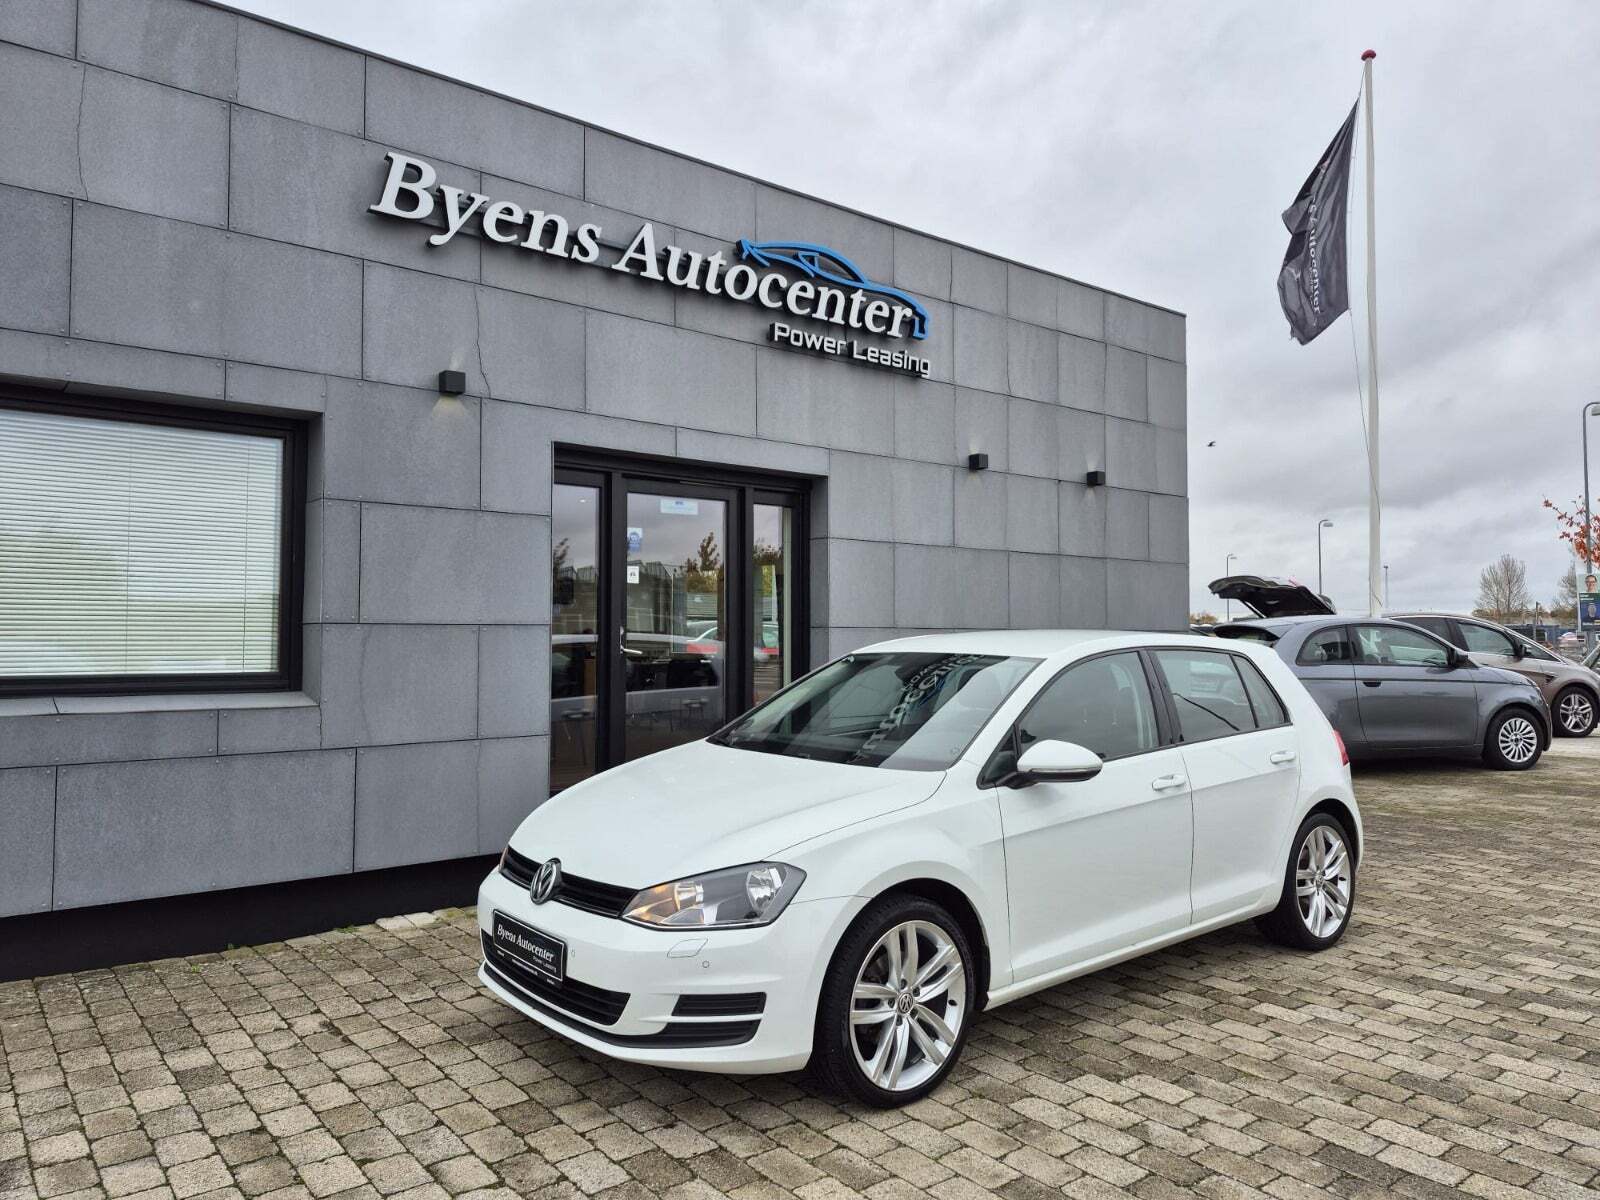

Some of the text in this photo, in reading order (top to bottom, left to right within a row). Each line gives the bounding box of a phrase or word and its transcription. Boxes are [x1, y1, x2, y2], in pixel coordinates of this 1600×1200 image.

[369, 151, 913, 338] Byens Autocenter
[774, 321, 931, 378] Power Leasing
[497, 923, 554, 962] Byens Autocenter
